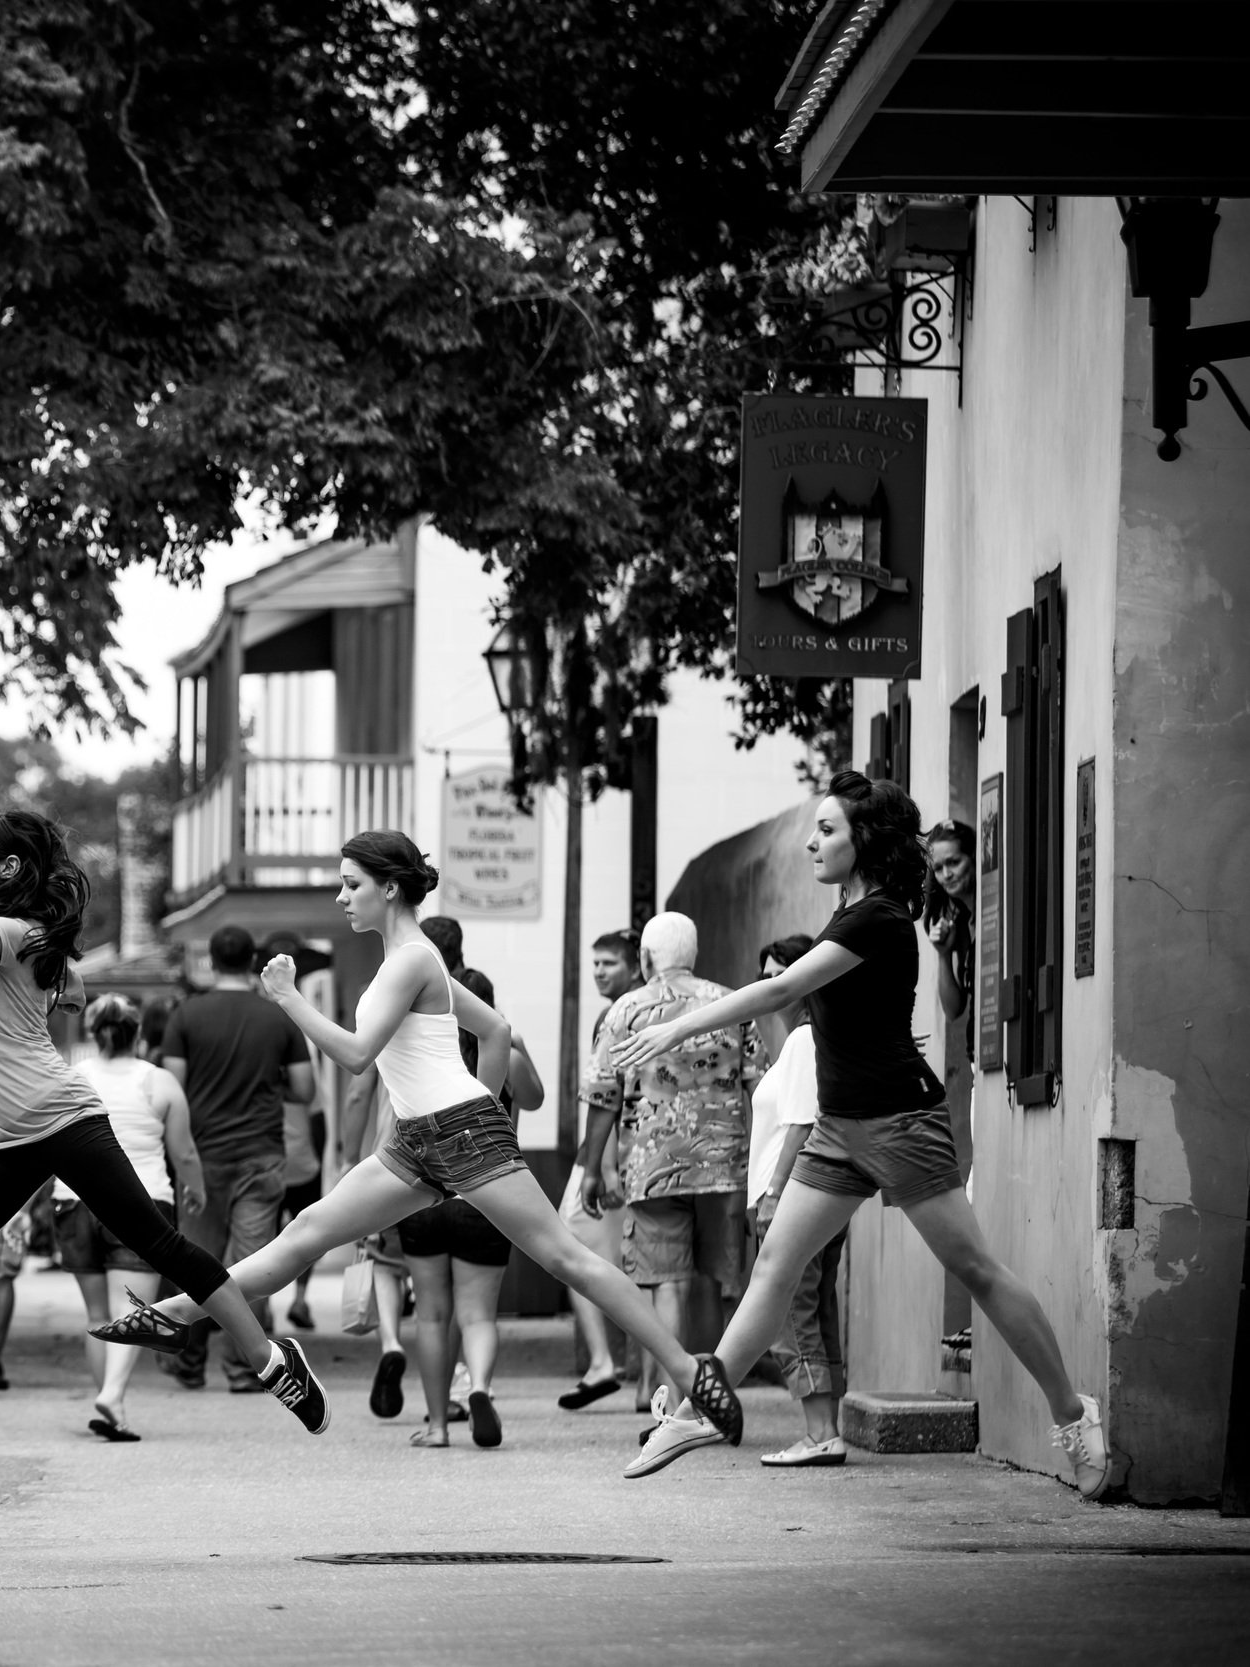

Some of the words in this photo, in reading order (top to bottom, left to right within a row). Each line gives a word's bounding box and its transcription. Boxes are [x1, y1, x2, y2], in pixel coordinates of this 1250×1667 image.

[751, 404, 916, 442] FLAGLER'S
[769, 443, 899, 471] LEGACY
[751, 634, 817, 650] TOURS
[824, 636, 839, 650] &
[848, 637, 908, 652] GIFTS
